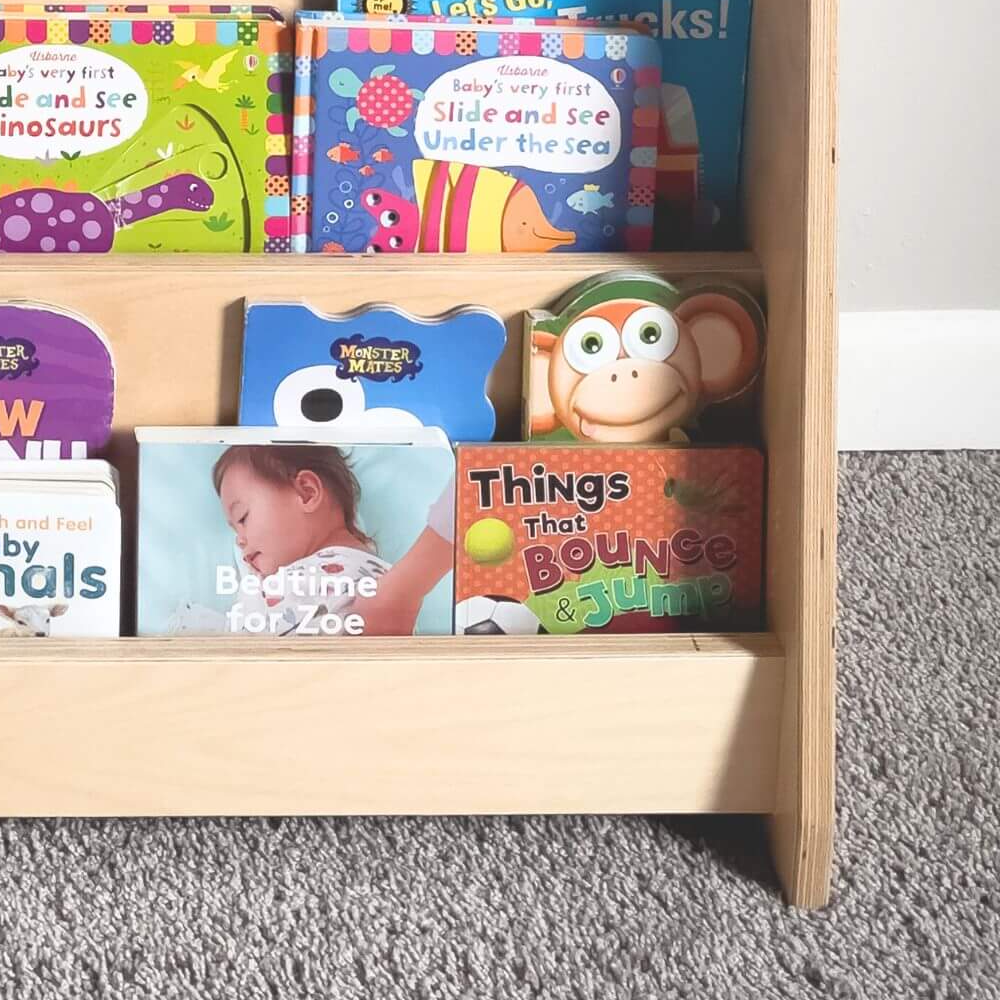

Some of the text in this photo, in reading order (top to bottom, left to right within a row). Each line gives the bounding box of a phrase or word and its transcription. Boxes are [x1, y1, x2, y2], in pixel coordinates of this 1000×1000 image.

[374, 1, 393, 11] me!
[30, 50, 77, 62] Usborne
[41, 67, 75, 83] very
[82, 66, 115, 80] first
[497, 64, 548, 77] Usborne
[36, 86, 86, 109] and
[96, 91, 137, 109] see
[453, 79, 591, 99] Baby's very first
[434, 100, 610, 126] Slide and see
[423, 128, 611, 155] Under the sea
[339, 344, 413, 363] MONSTER
[348, 359, 403, 374] MATES
[470, 464, 630, 513] Things
[16, 514, 49, 530] and
[56, 517, 92, 531] Feel
[523, 513, 587, 539] That
[216, 564, 378, 598] Bedtime
[226, 604, 364, 635] for Zoe
[556, 597, 576, 622] &
